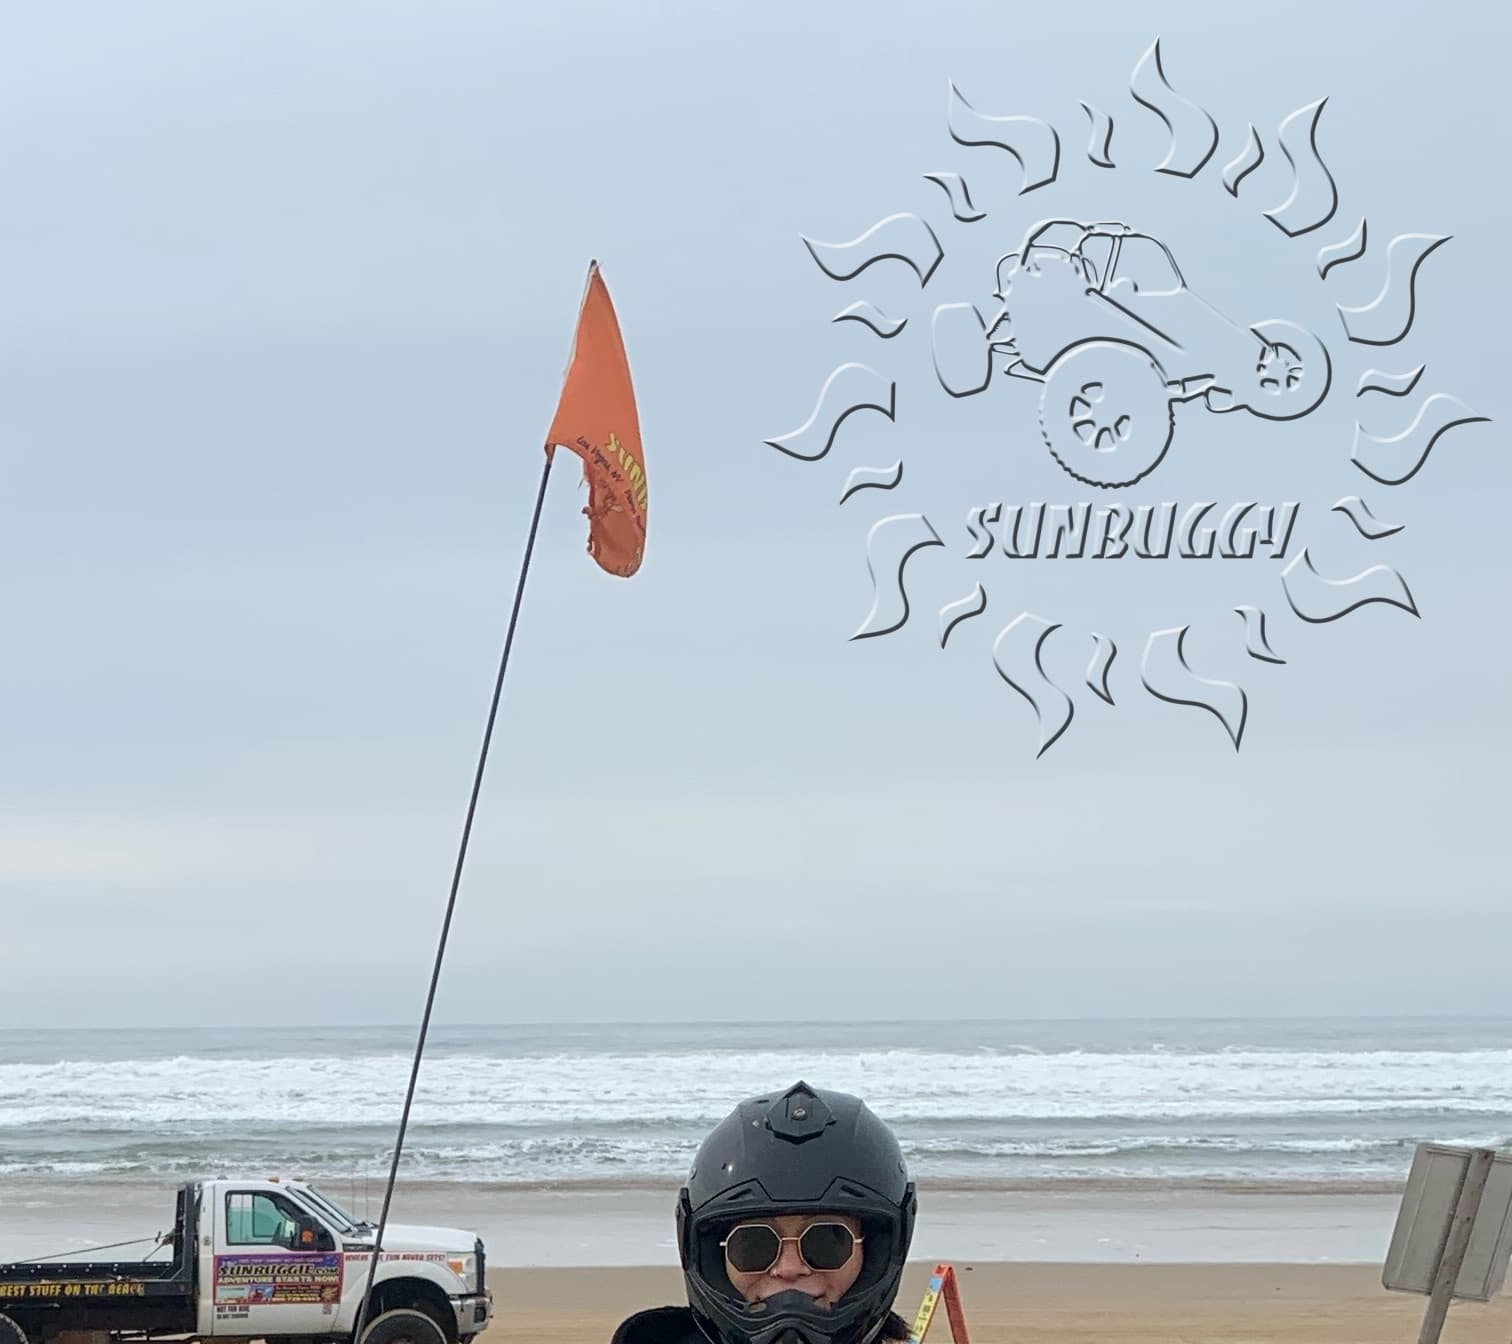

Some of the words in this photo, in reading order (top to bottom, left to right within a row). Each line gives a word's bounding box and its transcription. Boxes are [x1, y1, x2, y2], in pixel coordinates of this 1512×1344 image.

[0, 1285, 25, 1297] BEST
[29, 1284, 62, 1297] STUFF
[65, 1284, 81, 1296] ON
